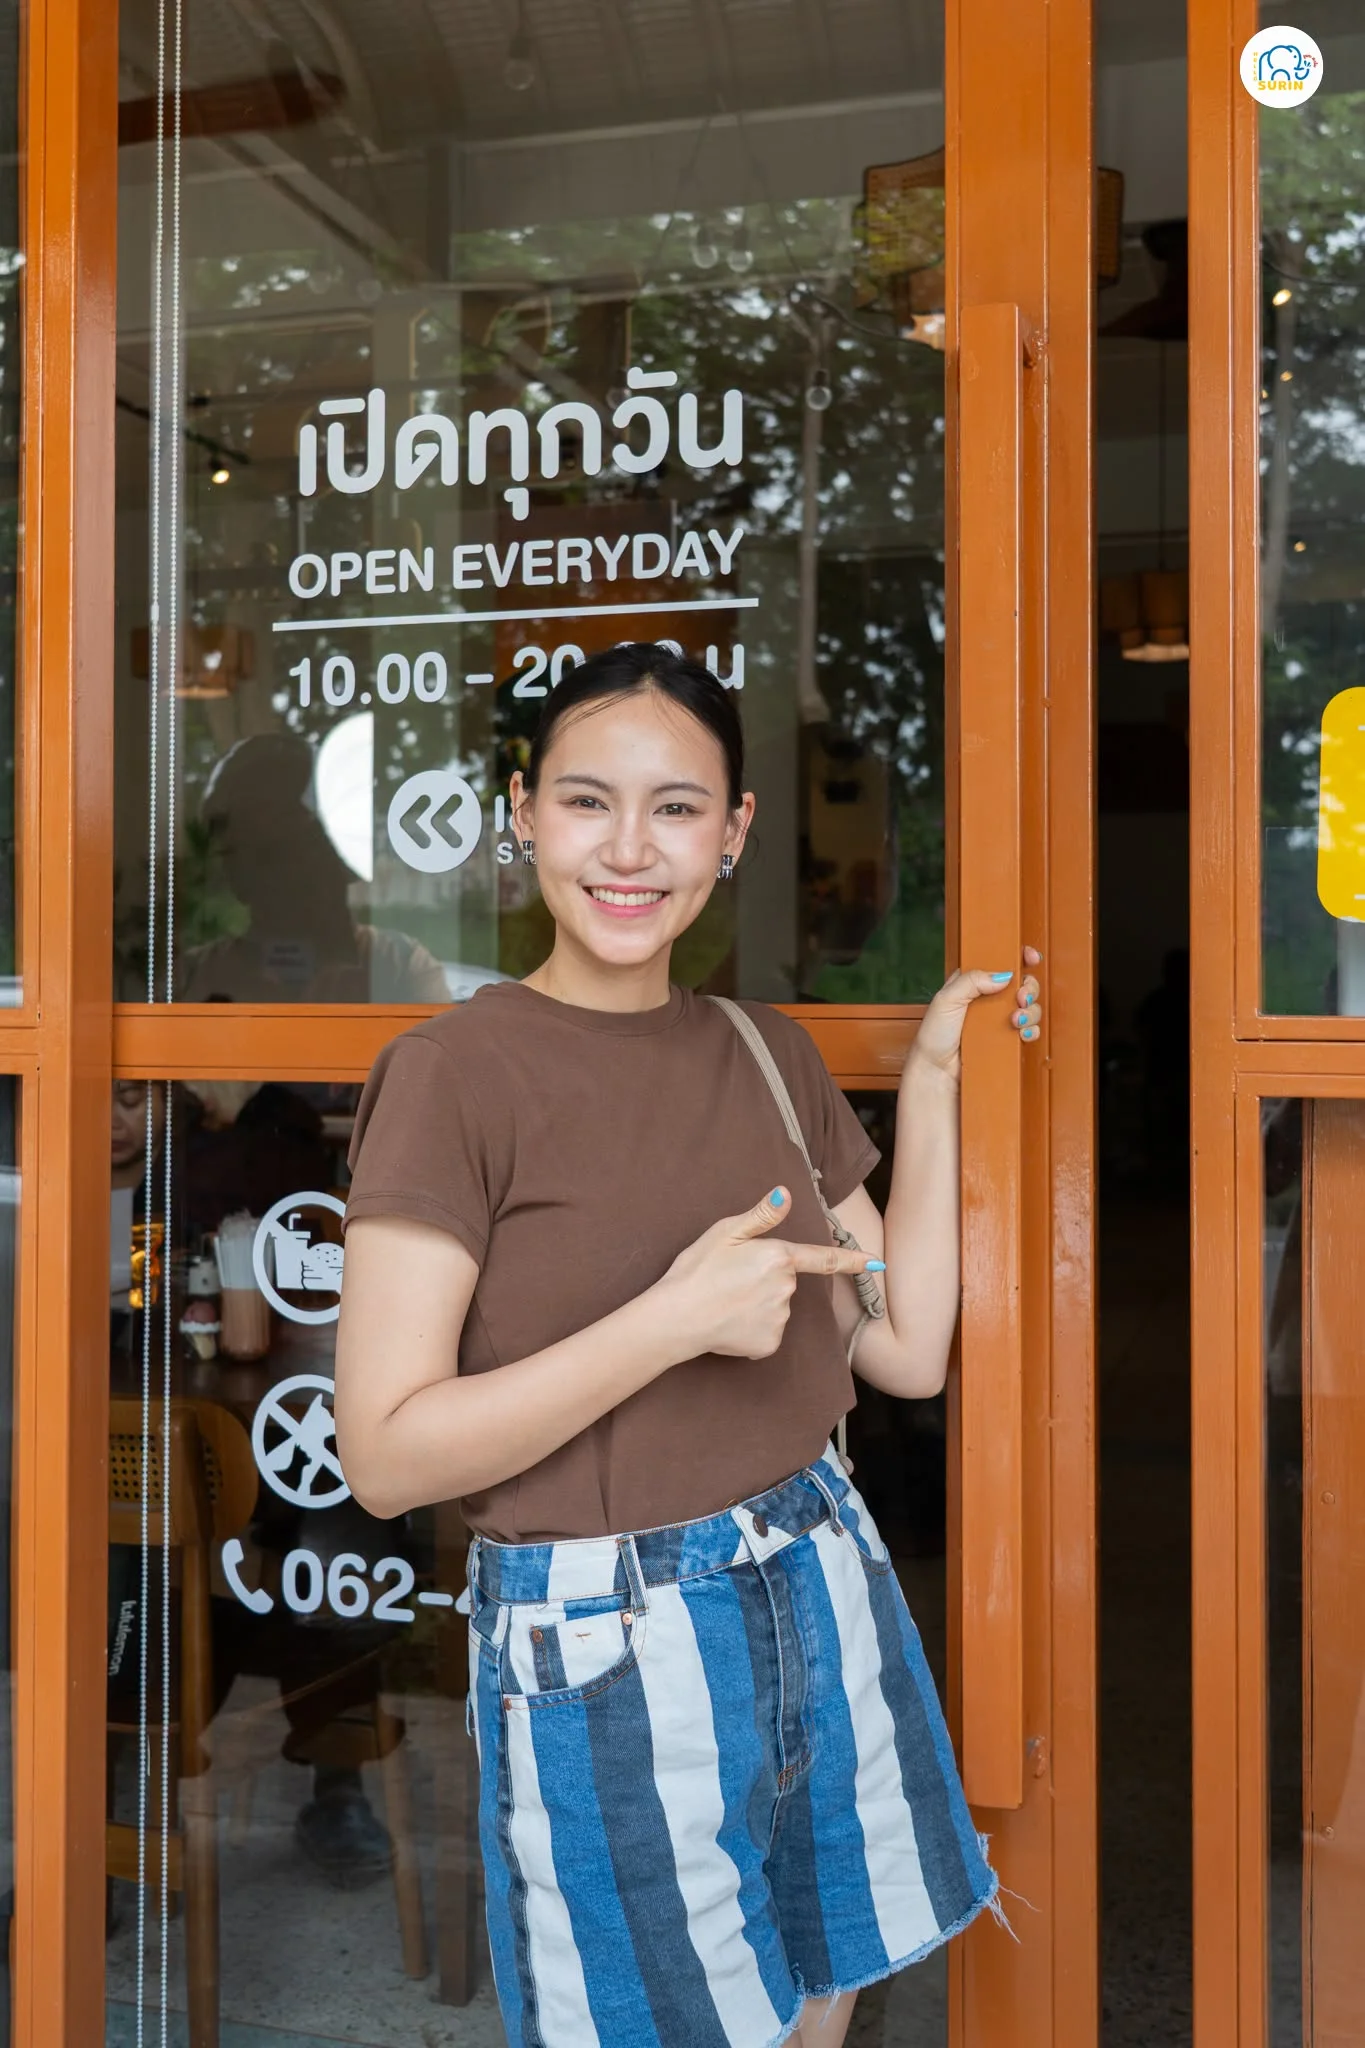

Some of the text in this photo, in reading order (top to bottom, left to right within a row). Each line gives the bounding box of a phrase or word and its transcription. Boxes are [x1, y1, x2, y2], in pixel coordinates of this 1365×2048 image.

[300, 366, 743, 521] เปิดทุกวัน
[288, 528, 744, 599] OPEN EVERYDAY
[289, 651, 448, 707] 10.00
[465, 673, 494, 685] -
[108, 1600, 137, 1676] lululemon
